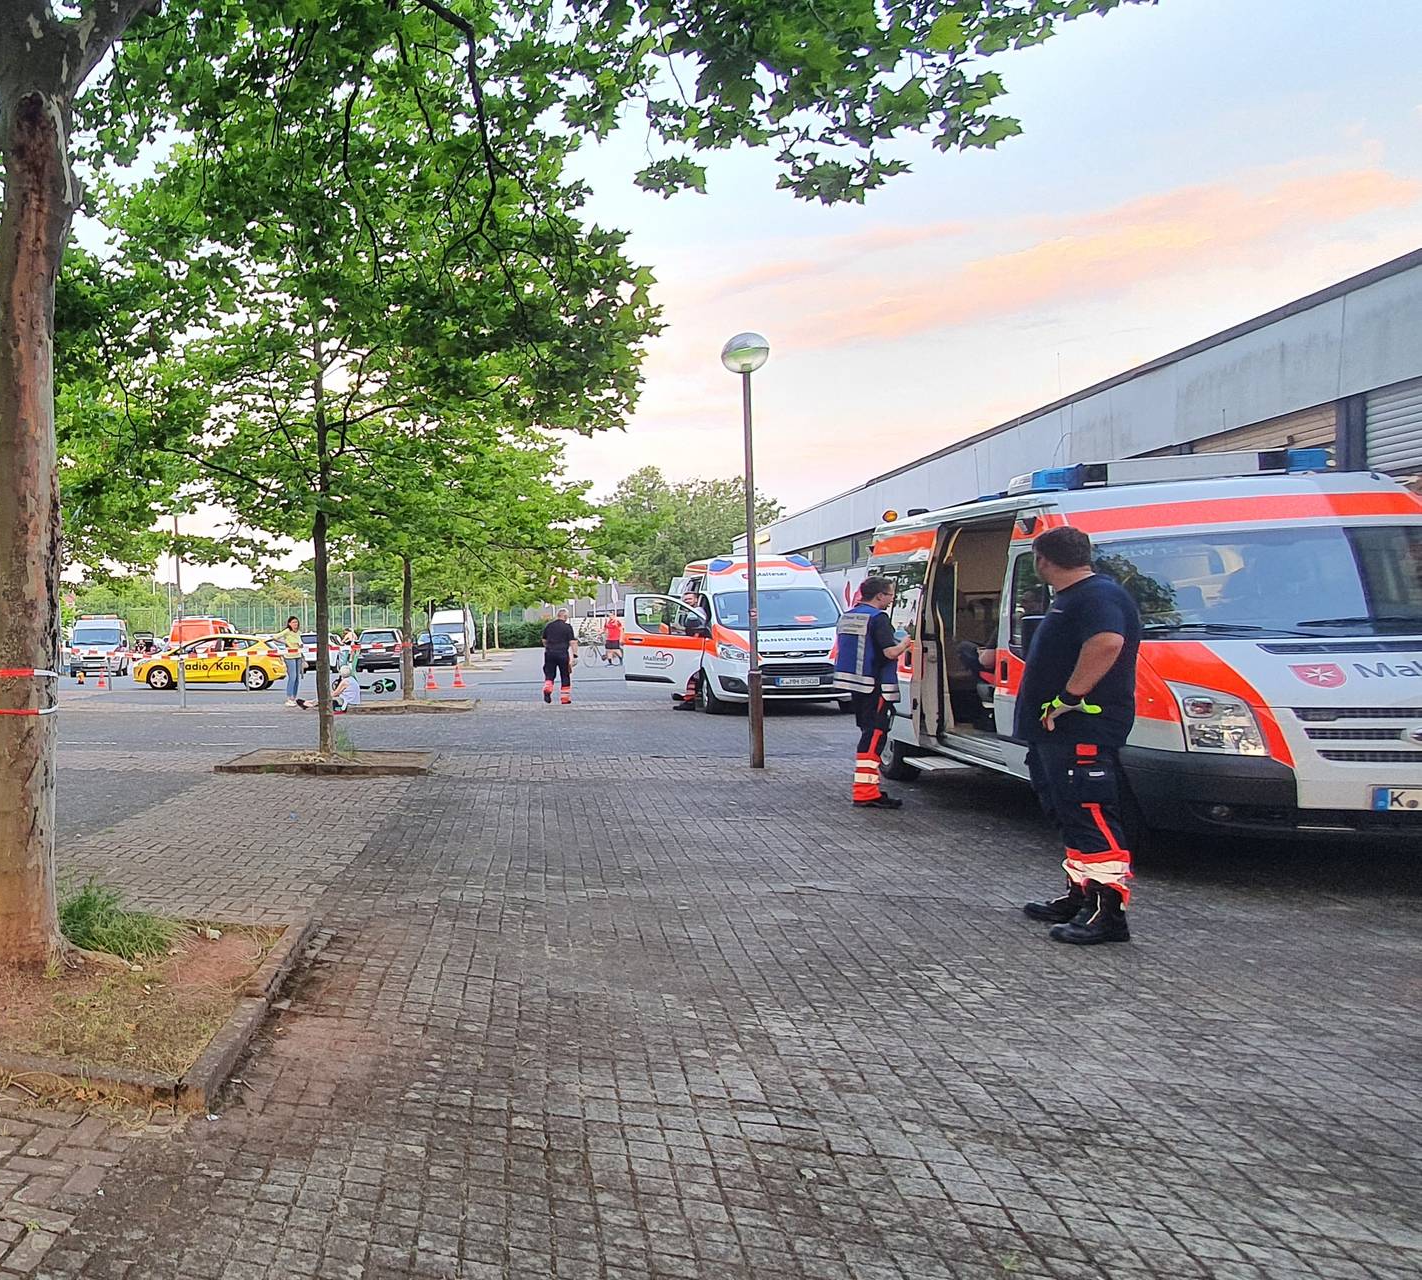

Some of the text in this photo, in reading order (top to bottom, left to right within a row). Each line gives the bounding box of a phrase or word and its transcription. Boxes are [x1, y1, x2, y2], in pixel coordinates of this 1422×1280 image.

[185, 661, 240, 671] adio Köln
[1390, 791, 1406, 807] K
